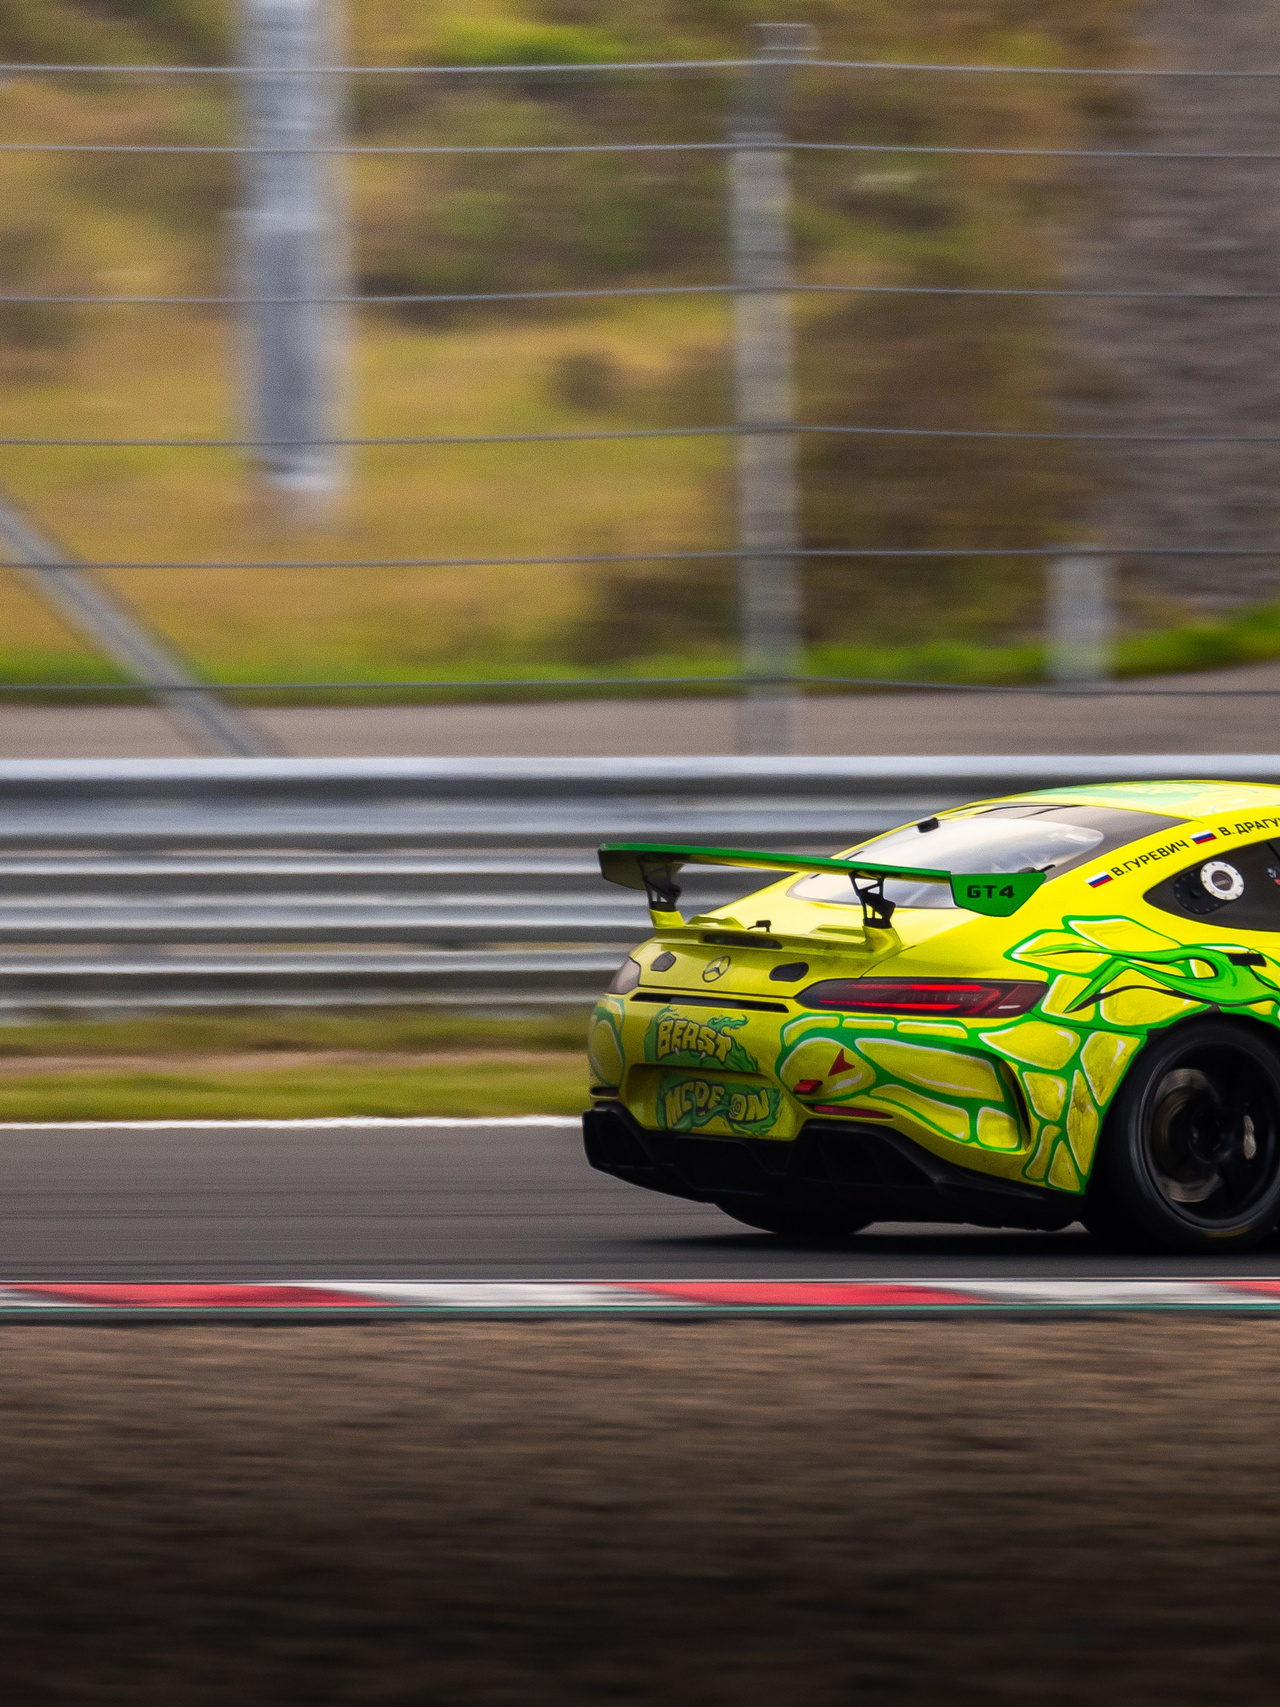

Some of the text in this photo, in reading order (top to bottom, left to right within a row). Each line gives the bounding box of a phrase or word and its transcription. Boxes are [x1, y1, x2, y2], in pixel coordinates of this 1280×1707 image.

[966, 884, 1015, 899] GT4
[656, 1018, 732, 1065] BEAST
[729, 1089, 770, 1122] ON
